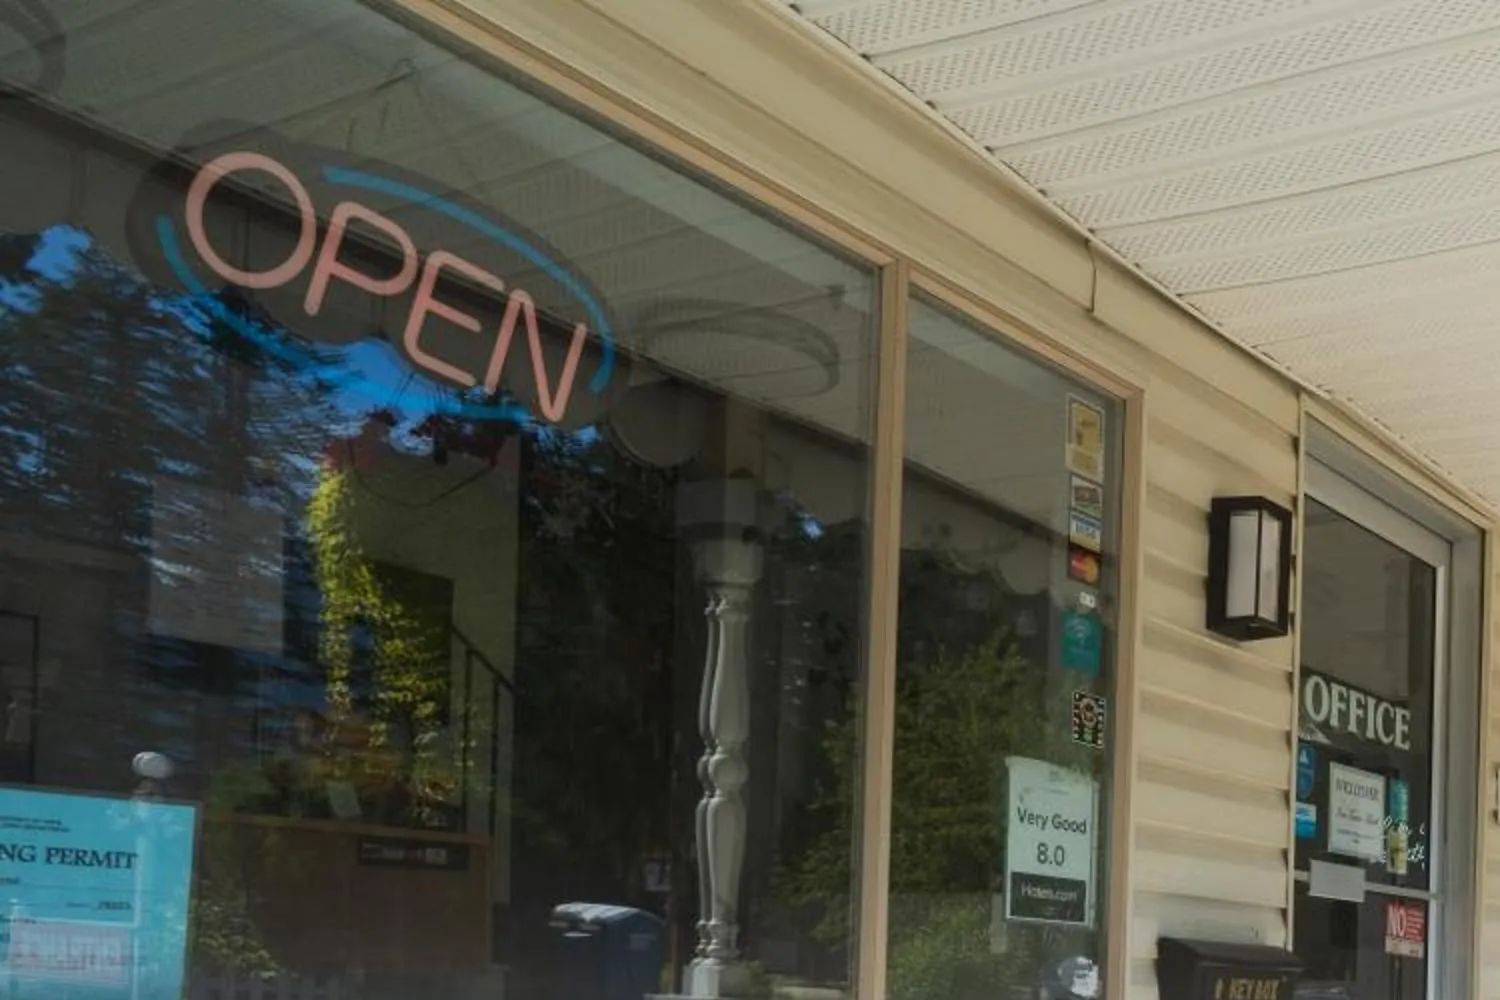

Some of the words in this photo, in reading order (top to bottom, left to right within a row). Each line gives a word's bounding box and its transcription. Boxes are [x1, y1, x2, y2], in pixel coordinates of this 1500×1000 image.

[185, 151, 588, 422] OPEN
[1303, 674, 1411, 750] OFFICE
[1017, 806, 1048, 830] Very
[1051, 812, 1087, 834] Good
[44, 846, 139, 869] PERMIT
[1036, 842, 1065, 866] 8.0
[1387, 903, 1407, 937] NO
